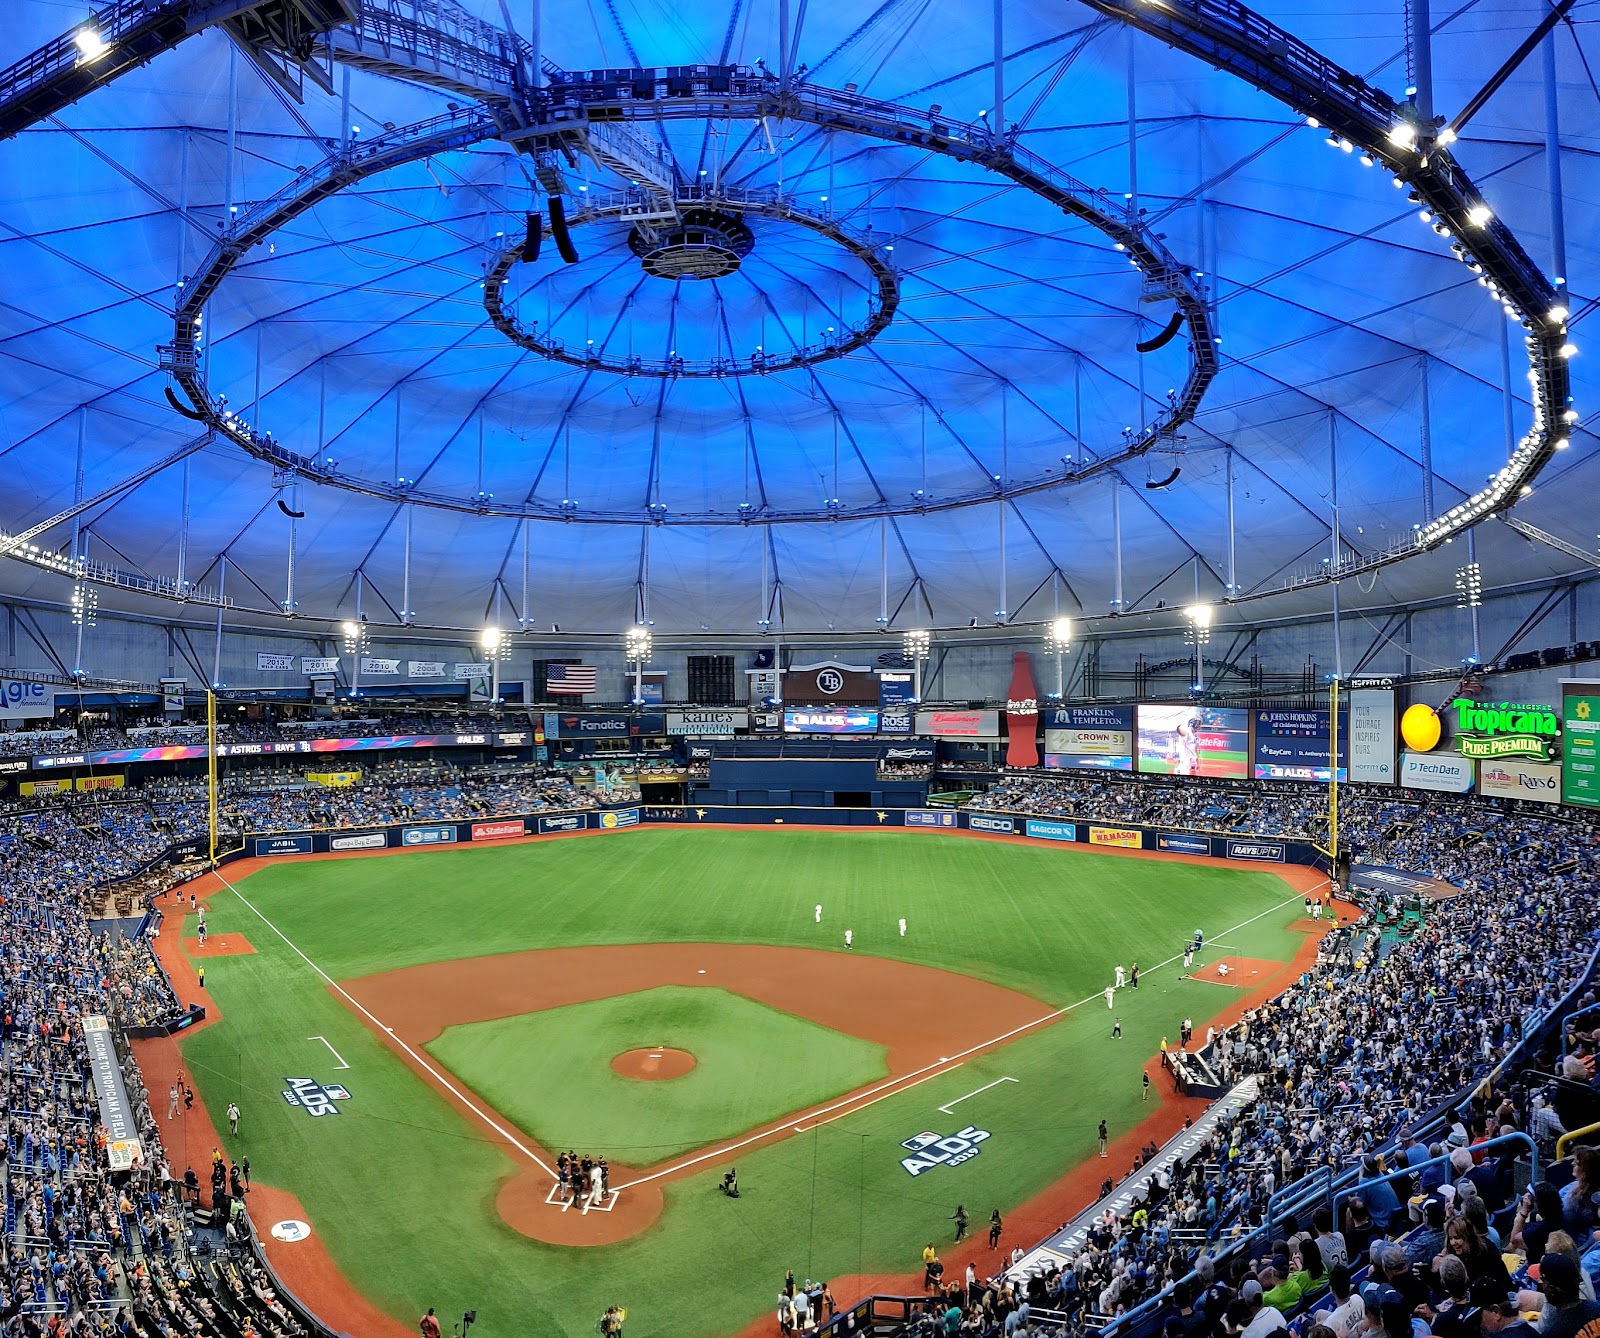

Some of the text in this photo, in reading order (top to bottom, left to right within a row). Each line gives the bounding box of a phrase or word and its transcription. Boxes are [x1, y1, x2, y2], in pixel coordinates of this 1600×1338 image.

[16, 698, 50, 709] financial
[1511, 703, 1552, 711] ORIGINAL
[1073, 709, 1115, 717] FRANKLIN
[1355, 706, 1370, 717] YOUR
[1453, 698, 1557, 736] Tropicana
[810, 715, 846, 725] ALDS
[881, 717, 910, 727] ROSE
[1072, 717, 1122, 725] TEMPLETON
[1269, 713, 1317, 723] JOHNS HOPKINS
[580, 719, 626, 730] Fanatics
[1355, 719, 1381, 730] COURAGE
[456, 735, 486, 744] #ALDS
[1077, 733, 1110, 741] CROWN
[1355, 732, 1380, 742] INSPIRES
[230, 744, 262, 754] ASTROS
[274, 743, 296, 753] RAYS
[1462, 739, 1542, 755] PURE PREMIUM
[1268, 749, 1292, 757] BayCare
[66, 755, 85, 764] ALDS
[1284, 767, 1313, 778] ALDS
[84, 777, 116, 789] HOT SAUCE
[1546, 775, 1556, 789] 6
[545, 817, 578, 828] Spectrum
[970, 817, 1012, 831] GEICO
[1030, 824, 1062, 835] SAGICOR
[92, 1032, 109, 1062] WELCOME
[99, 1061, 111, 1071] TO
[101, 1070, 121, 1113] TROPICANA
[282, 1090, 301, 1106] 2019
[286, 1078, 339, 1117] ALDS
[110, 1113, 127, 1139] FIELD
[901, 1126, 991, 1176] ALDS
[946, 1147, 979, 1167] 2019
